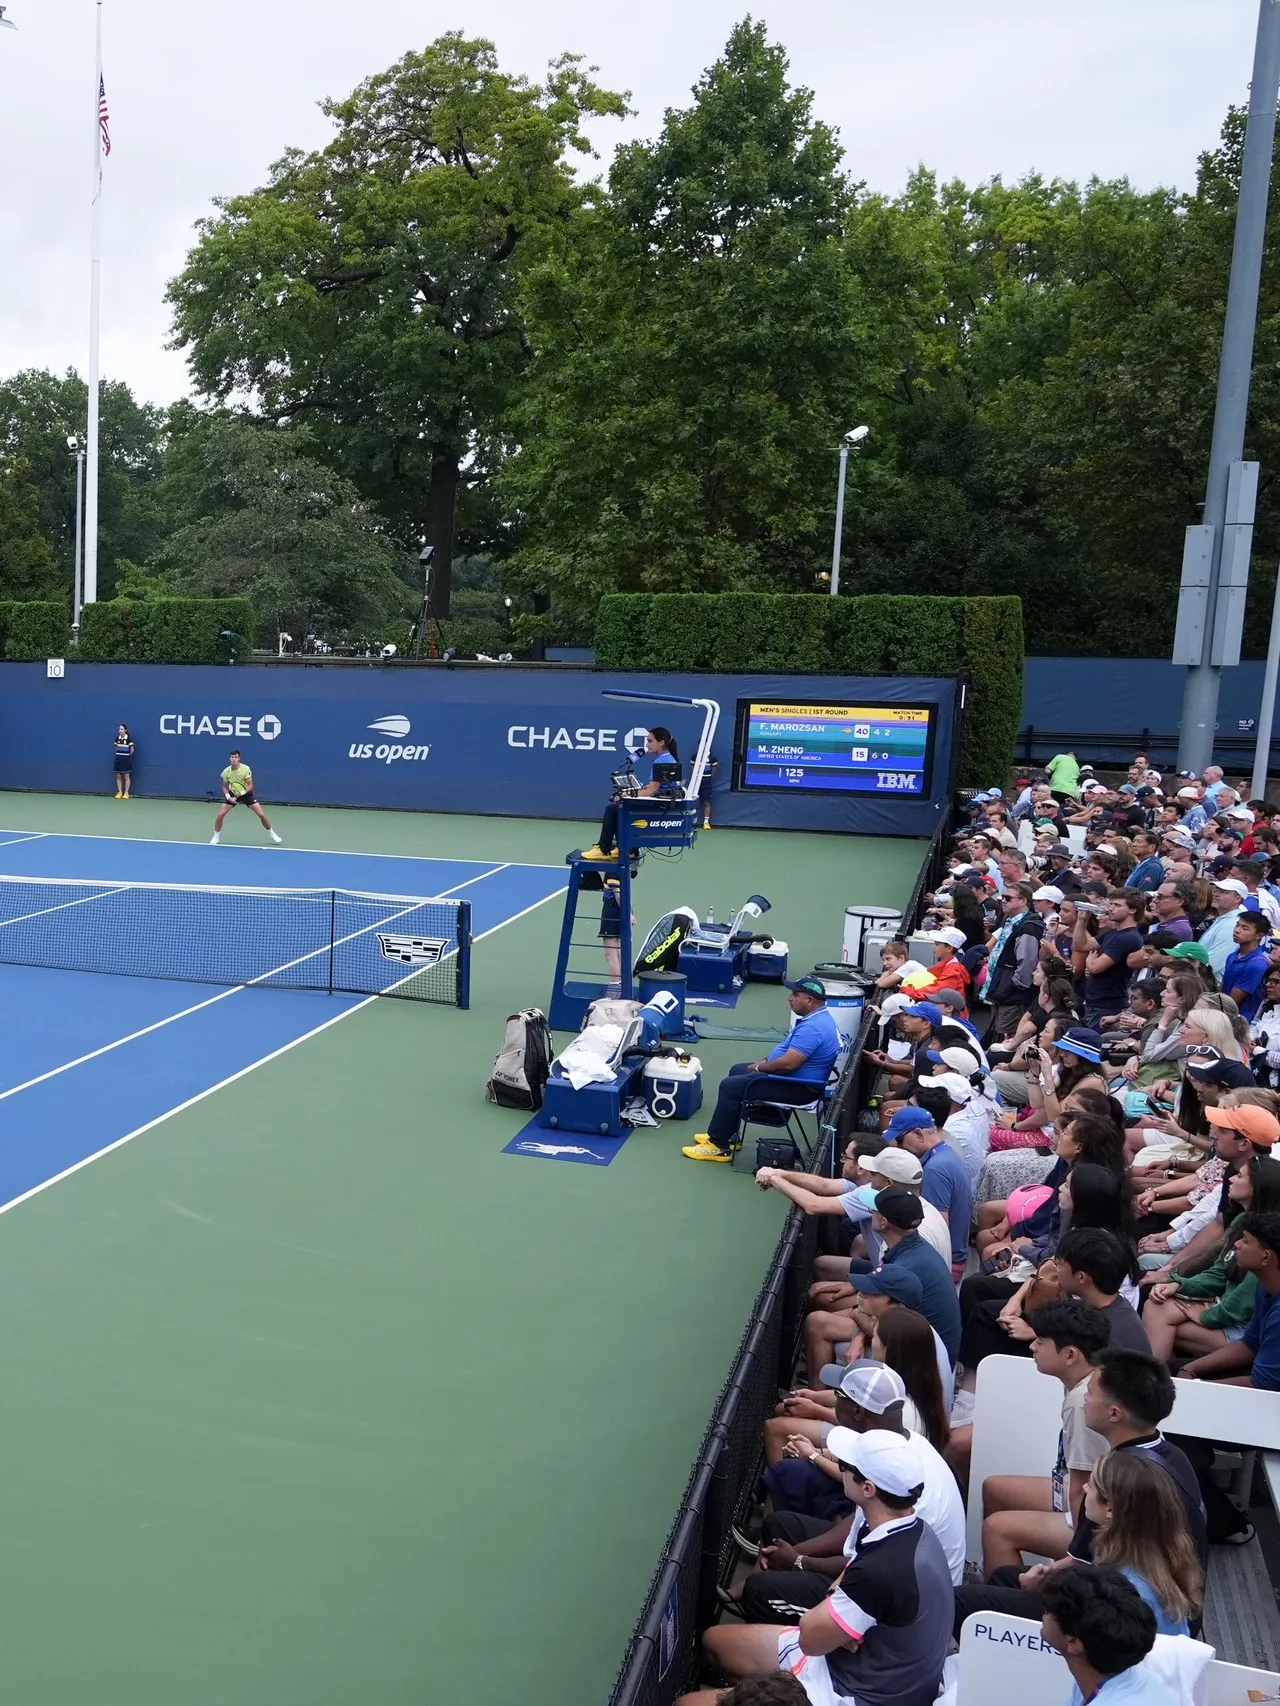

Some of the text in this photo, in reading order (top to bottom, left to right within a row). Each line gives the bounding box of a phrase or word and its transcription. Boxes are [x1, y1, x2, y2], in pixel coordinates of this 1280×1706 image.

[49, 665, 61, 676] 10
[159, 714, 252, 736] CHASE
[760, 722, 768, 730] F.
[771, 723, 825, 732] MAROZSAN
[507, 725, 618, 751] CHASE
[348, 743, 430, 764] us open
[758, 745, 768, 753] M.
[771, 746, 804, 754] ZHENG
[785, 768, 804, 777] 125
[876, 772, 917, 789] IBM
[660, 820, 682, 829] open
[503, 1073, 520, 1084] YONEX
